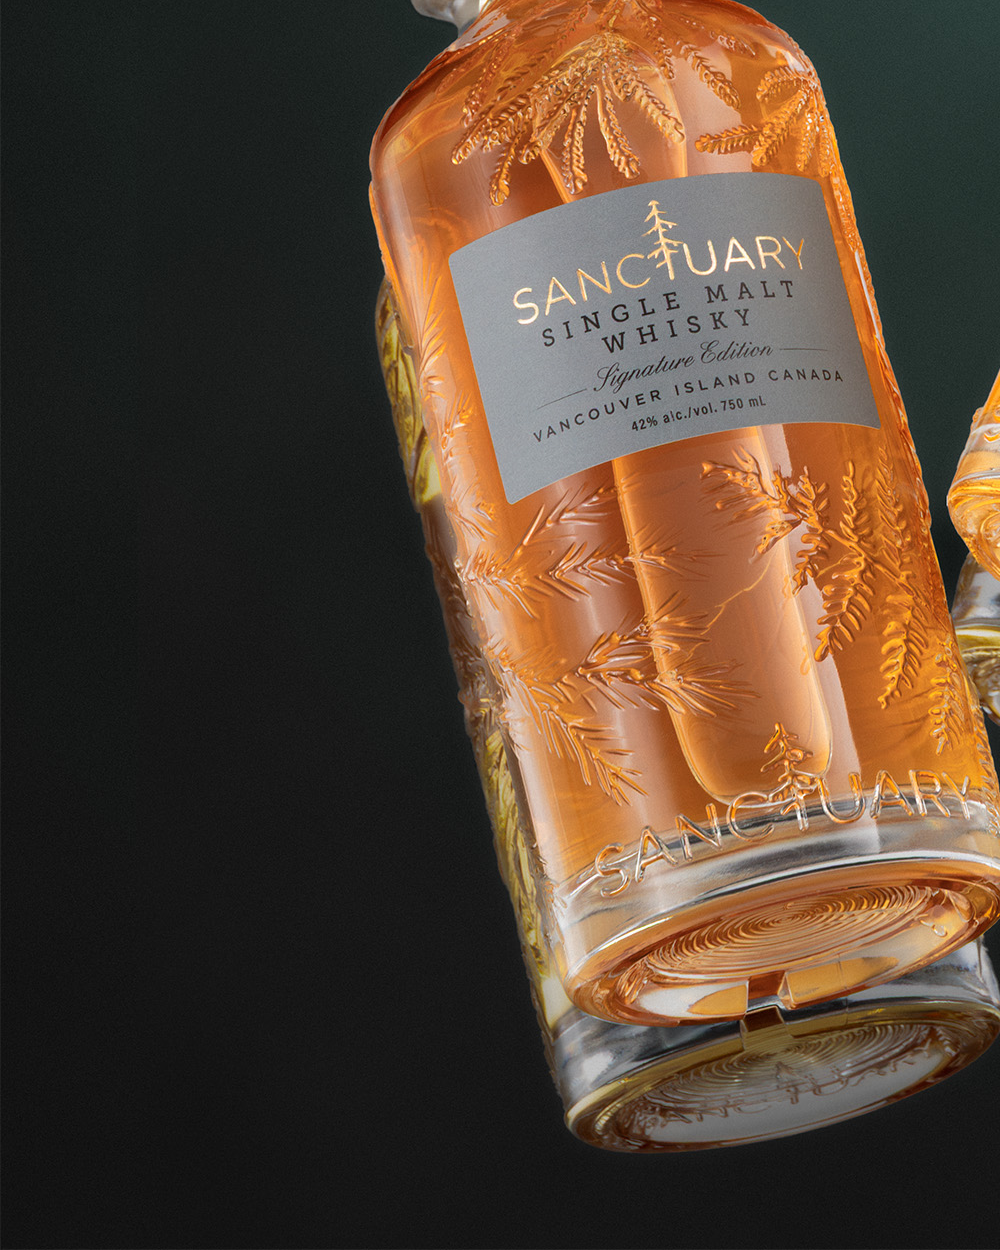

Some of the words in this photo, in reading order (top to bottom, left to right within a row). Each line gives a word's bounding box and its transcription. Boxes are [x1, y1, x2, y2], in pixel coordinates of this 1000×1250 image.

[512, 199, 806, 326] SANCTUARY
[541, 290, 681, 348] SINGLE
[705, 279, 796, 304] MALT
[601, 307, 752, 355] WHISKY
[593, 355, 696, 395] Signature
[700, 339, 774, 365] Edition
[532, 389, 662, 443] VANCOUVER
[674, 372, 756, 397] ISLAND
[767, 368, 844, 383] CANADA
[631, 415, 659, 432] 42%
[662, 401, 719, 424] alc./vol.
[719, 397, 745, 412] 750
[748, 395, 767, 408] mL
[594, 721, 973, 899] SANCTUARY
